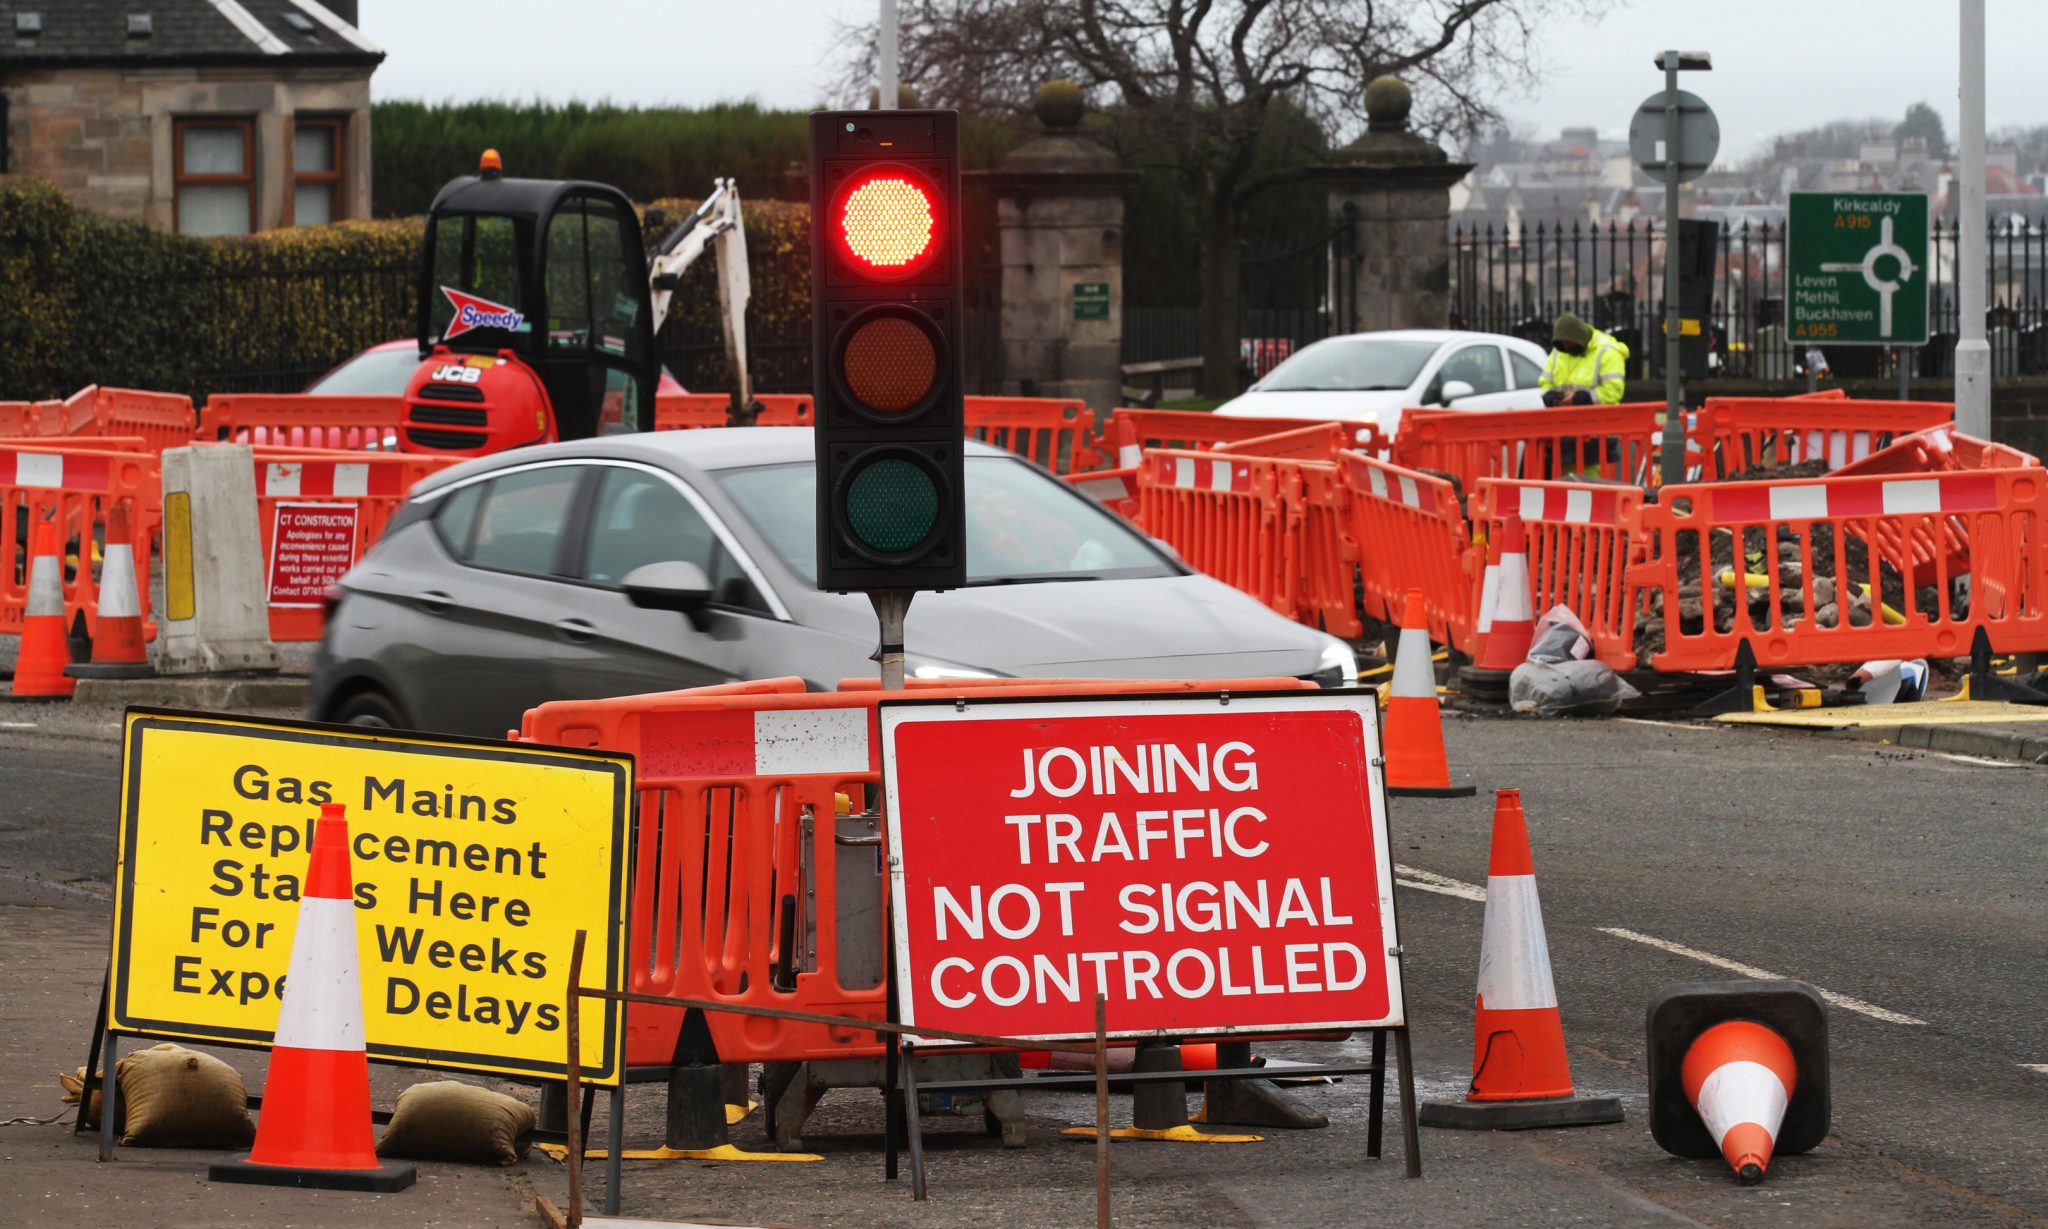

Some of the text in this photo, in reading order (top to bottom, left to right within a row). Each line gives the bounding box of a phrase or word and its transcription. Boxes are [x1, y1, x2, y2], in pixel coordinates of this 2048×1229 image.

[1833, 198, 1901, 215] Kirkcaldy
[1795, 273, 1837, 287] Leven
[1795, 290, 1839, 304] Methil
[462, 305, 523, 331] Speedy
[1795, 306, 1873, 321] Buckhaven
[432, 365, 482, 383] JCB
[280, 514, 354, 527] CT CONSTRUCTION
[324, 531, 333, 540] for
[335, 532, 346, 541] any
[280, 541, 350, 551] inconvenience caused
[279, 553, 349, 563] during these essential
[280, 564, 300, 573] works
[302, 565, 325, 574] carried
[290, 575, 311, 585] behalf
[272, 586, 300, 596] Contact
[1010, 741, 1258, 799] JOINING
[233, 764, 517, 825] Gas Mains
[200, 808, 547, 879] Replcement
[1005, 806, 1270, 864] TRAFFIC
[209, 859, 530, 927] Stas Here
[933, 877, 1353, 941] NOT SIGNAL
[191, 906, 547, 979] For Weeks
[930, 942, 1366, 1009] CONTROLLED
[386, 976, 561, 1035] Delays
